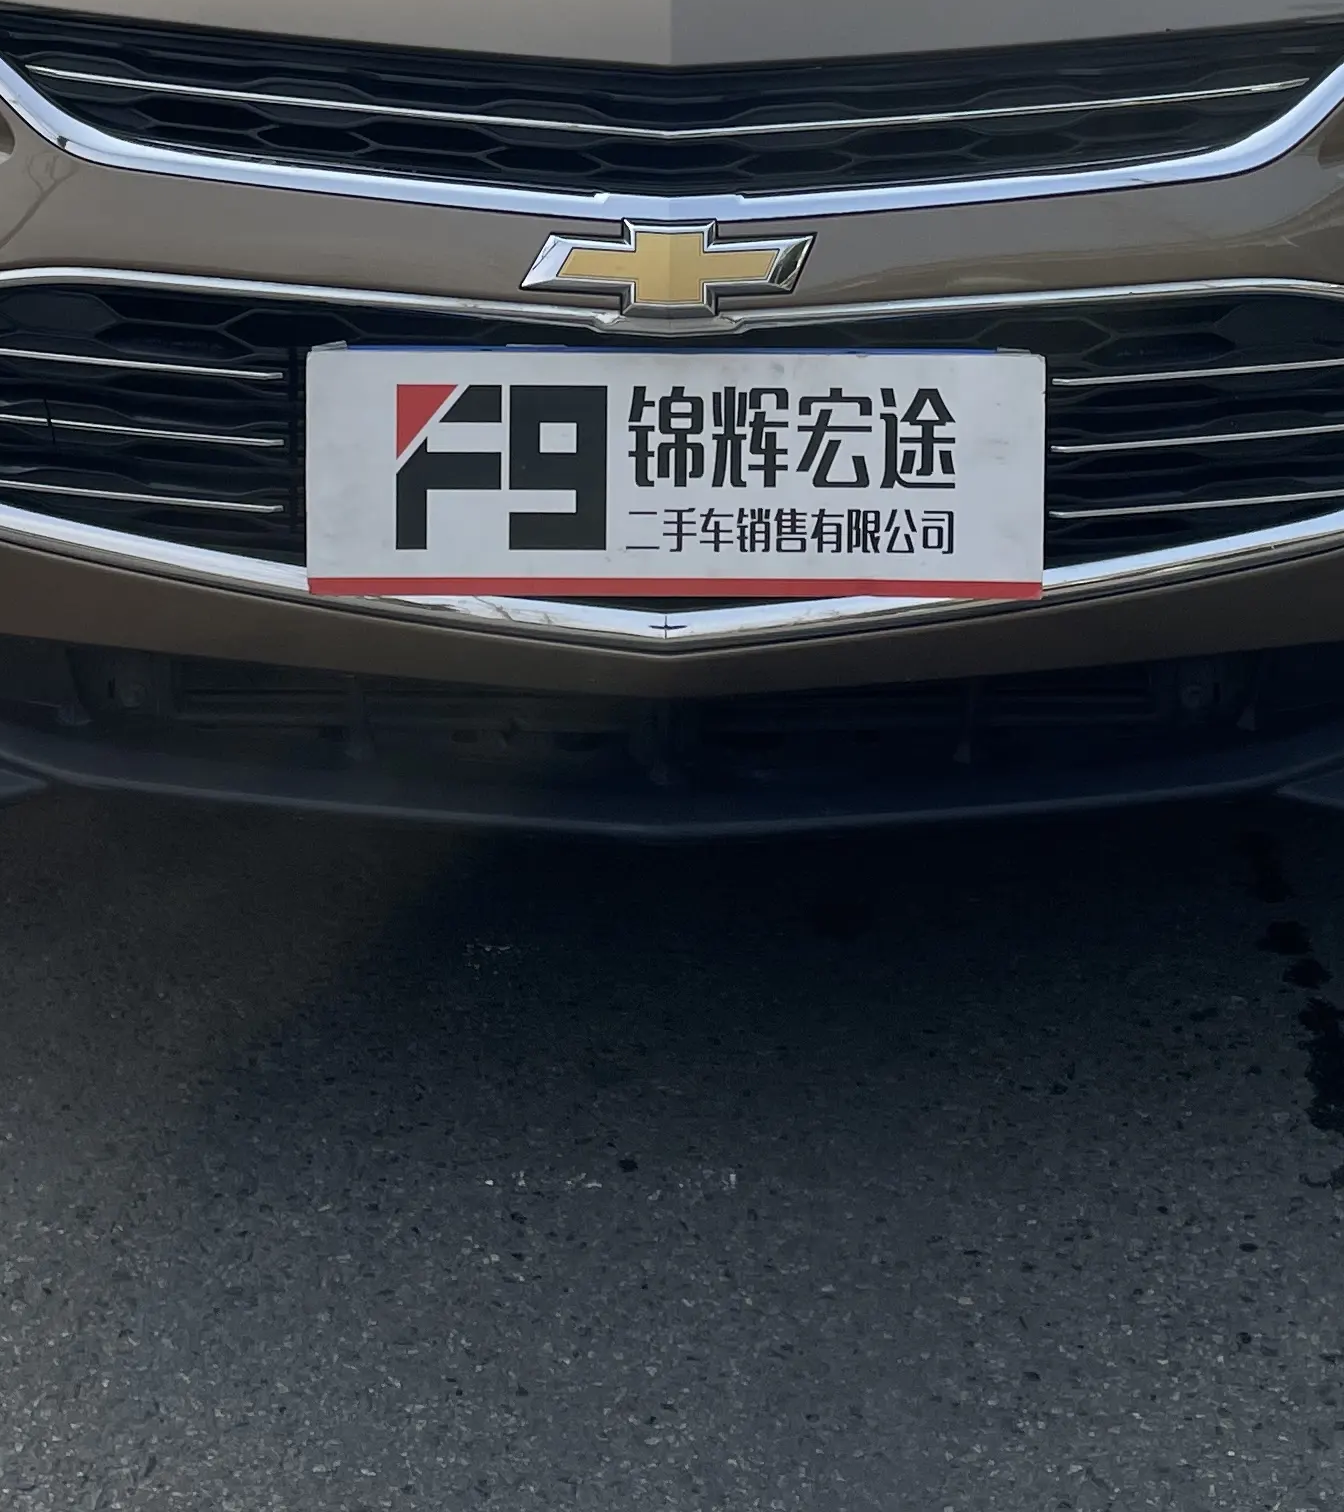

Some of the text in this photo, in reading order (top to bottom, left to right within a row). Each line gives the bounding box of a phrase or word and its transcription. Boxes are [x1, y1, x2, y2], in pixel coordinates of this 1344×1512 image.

[627, 384, 957, 490] 锦辉宏途
[625, 507, 956, 555] 二手车销售有限公司
